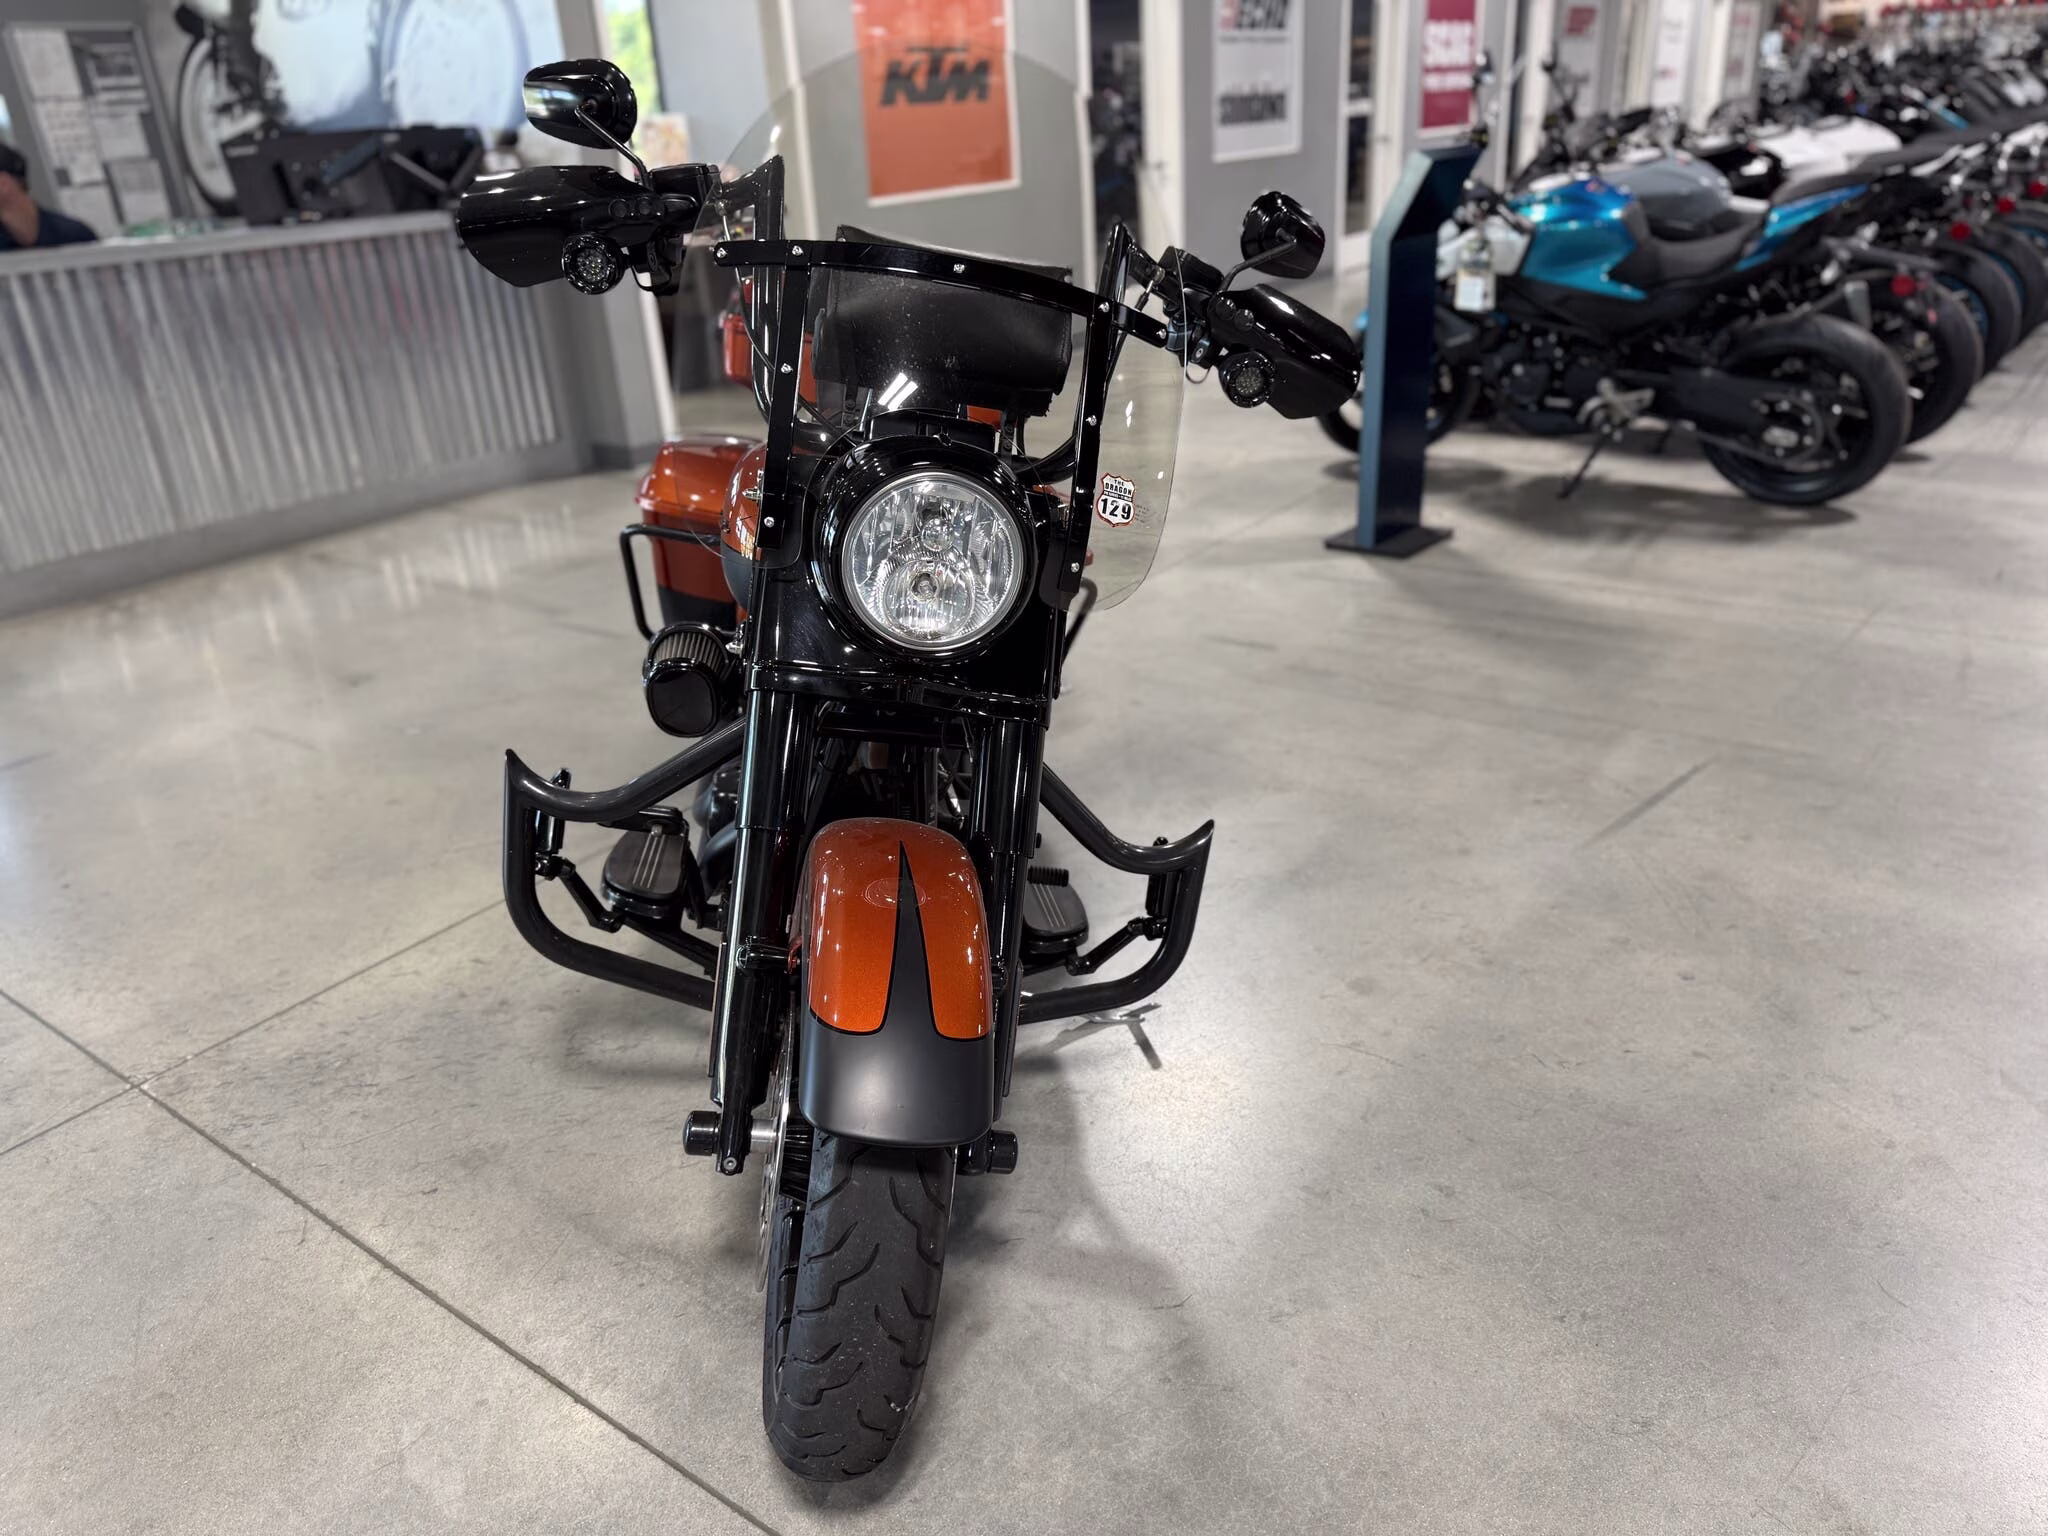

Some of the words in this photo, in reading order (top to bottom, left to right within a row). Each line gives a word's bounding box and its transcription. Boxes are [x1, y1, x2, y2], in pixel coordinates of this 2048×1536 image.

[880, 44, 991, 106] KTM
[1105, 482, 1132, 495] DRAGON
[1114, 479, 1124, 487] THE
[1101, 498, 1132, 520] 129
